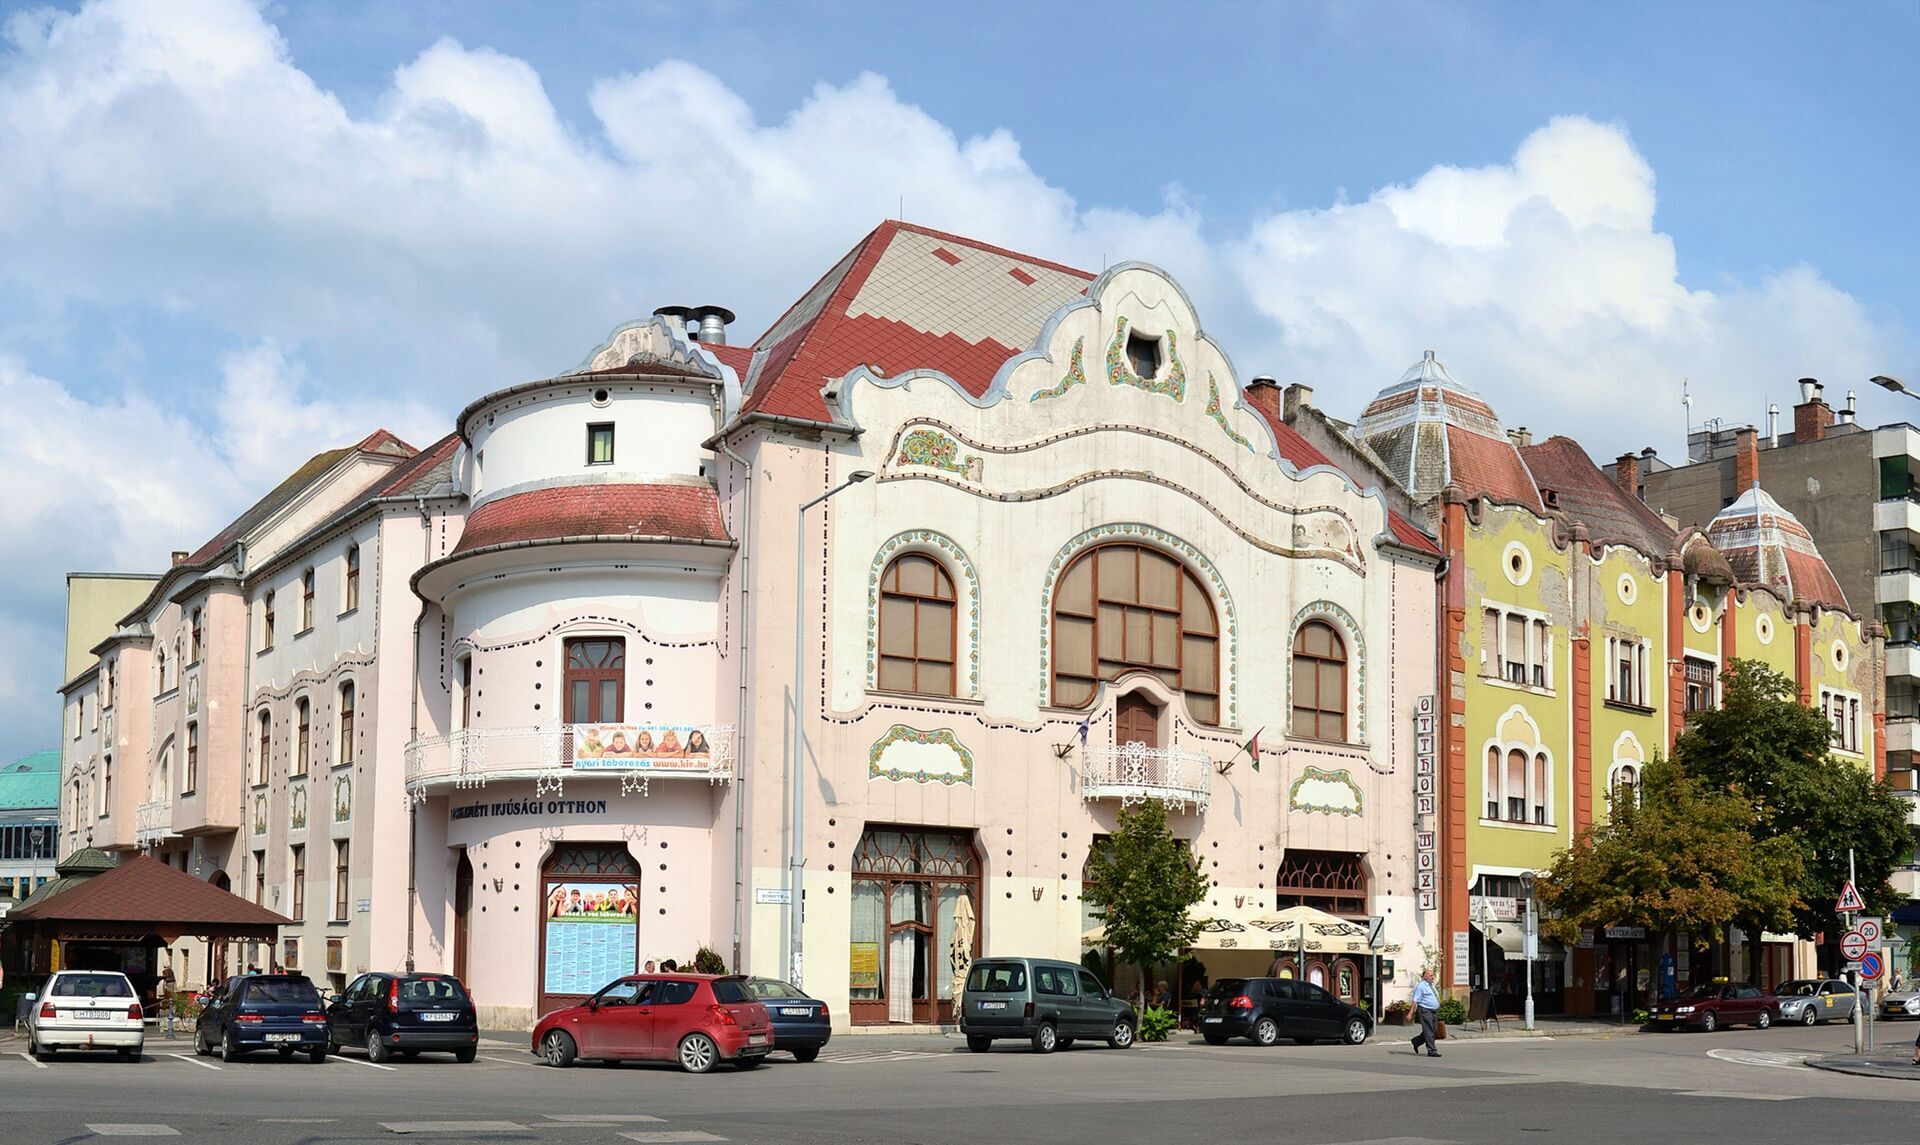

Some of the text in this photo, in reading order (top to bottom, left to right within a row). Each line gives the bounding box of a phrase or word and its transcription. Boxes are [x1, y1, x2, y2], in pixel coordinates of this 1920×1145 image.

[491, 797, 543, 816] IFJÚSÁGI
[547, 800, 607, 814] OTTHON
[1864, 927, 1874, 936] 20
